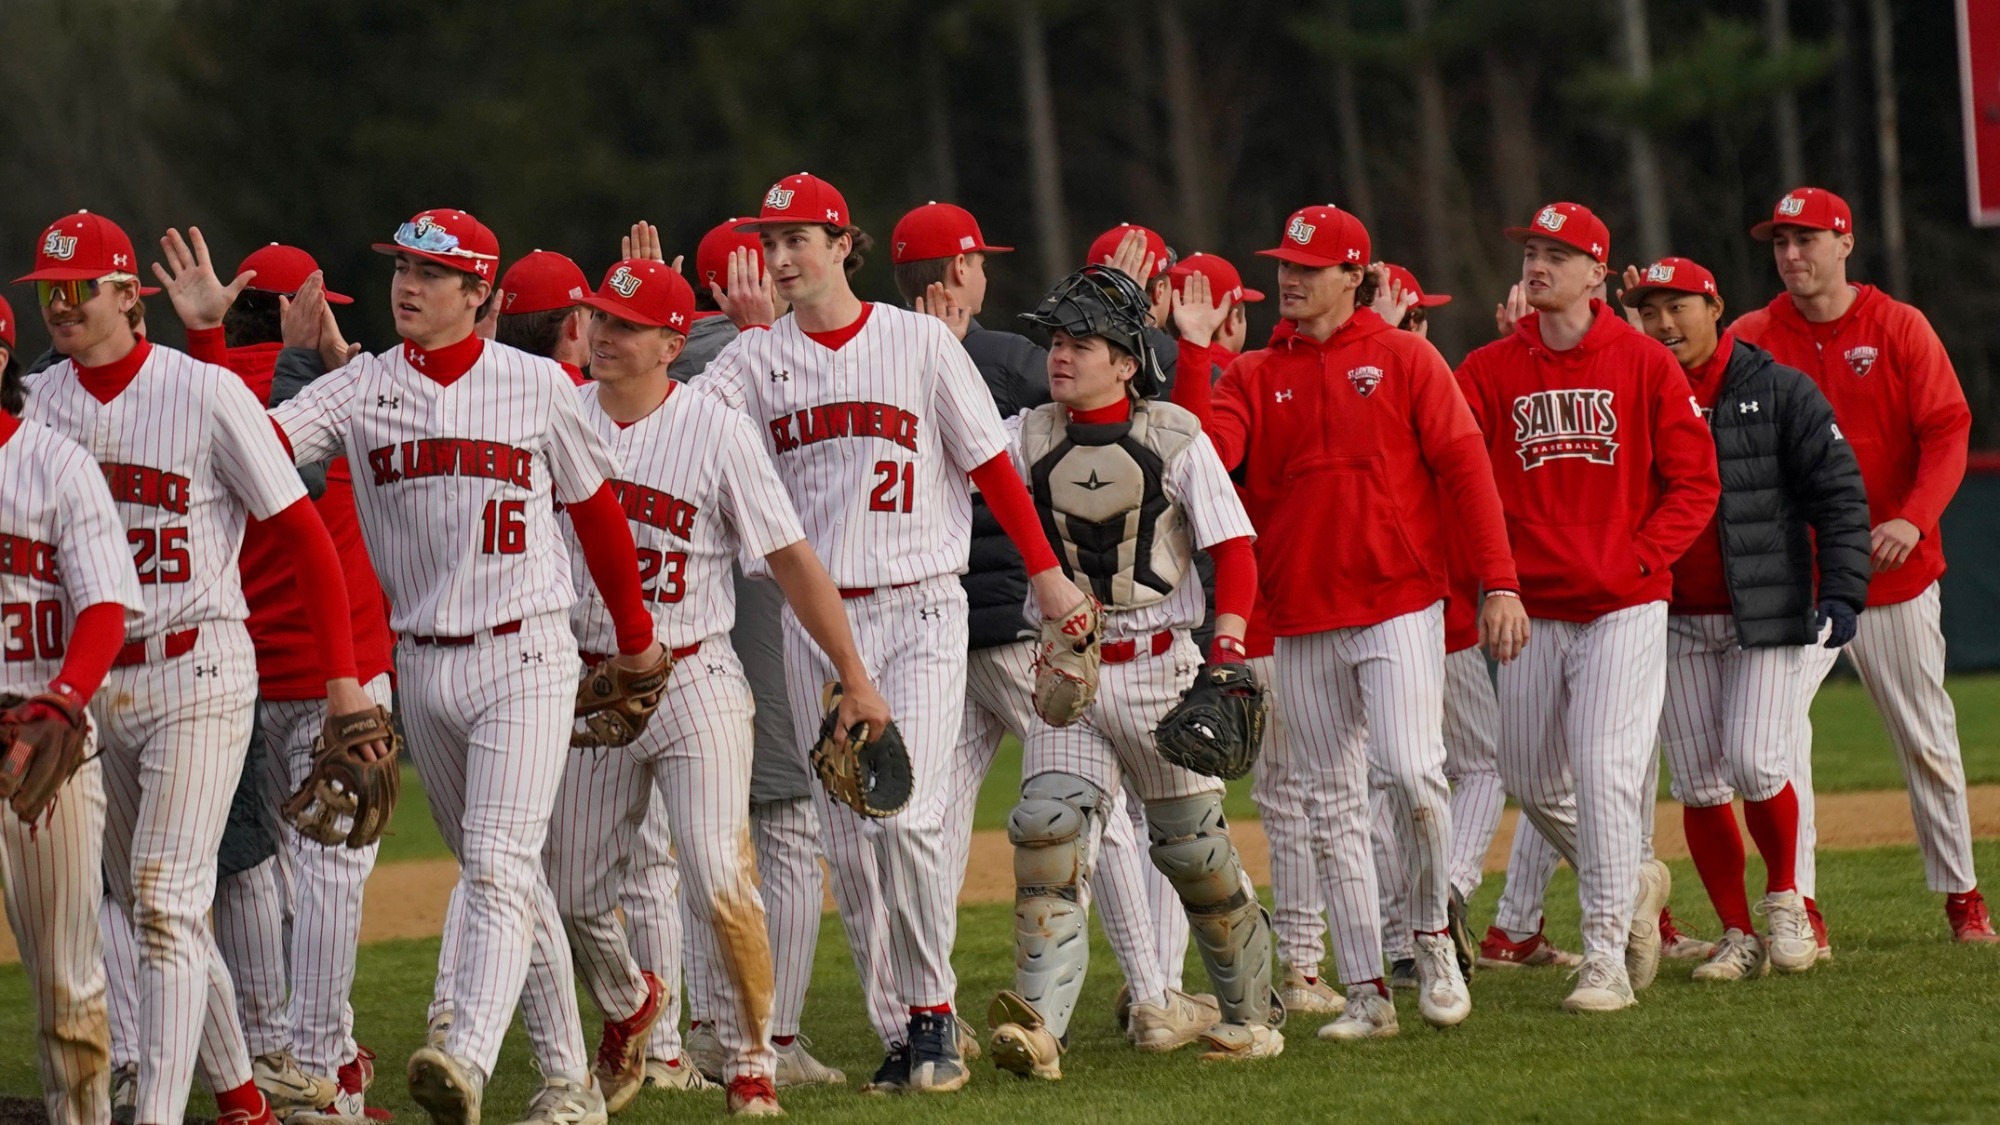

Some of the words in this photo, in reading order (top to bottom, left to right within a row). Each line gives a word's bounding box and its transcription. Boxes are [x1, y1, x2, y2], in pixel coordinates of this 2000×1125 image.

[770, 415, 799, 455] ST.
[796, 401, 919, 453] LAWRENCE
[1512, 389, 1617, 442] SAINTS
[369, 443, 402, 487] ST.
[402, 438, 532, 491] LAWRENCE
[1532, 443, 1599, 454] BASEBALL
[869, 460, 915, 514] 21
[482, 499, 526, 555] 16
[127, 527, 190, 585] 25
[637, 547, 688, 604] 23
[2, 600, 65, 662] 30
[341, 719, 378, 737] Wilson
